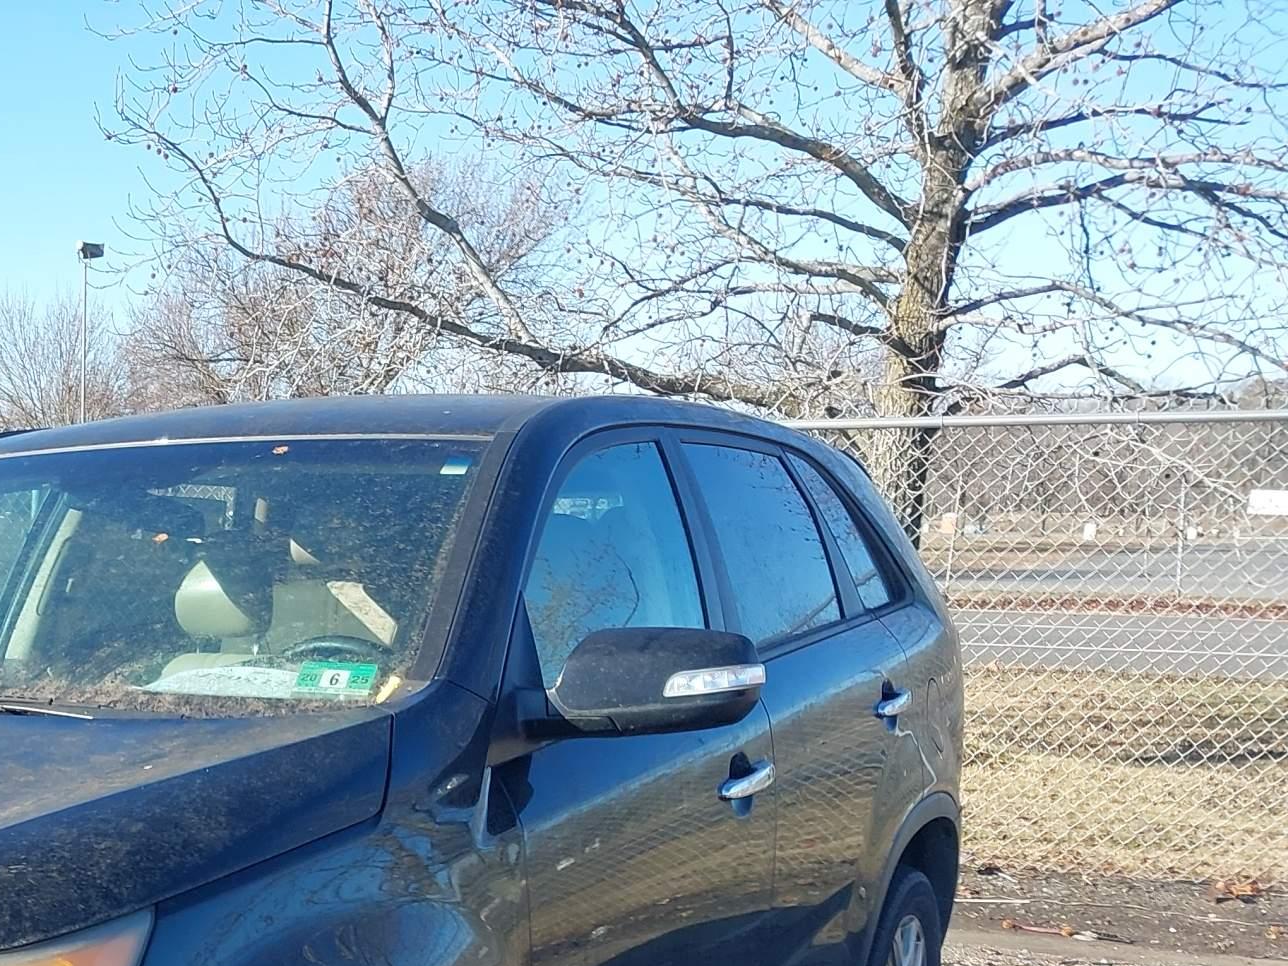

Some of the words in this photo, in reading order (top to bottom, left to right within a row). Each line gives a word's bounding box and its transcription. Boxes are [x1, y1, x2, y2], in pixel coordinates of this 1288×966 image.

[300, 673, 318, 682] 20
[329, 672, 341, 686] 6
[351, 675, 369, 684] 25
